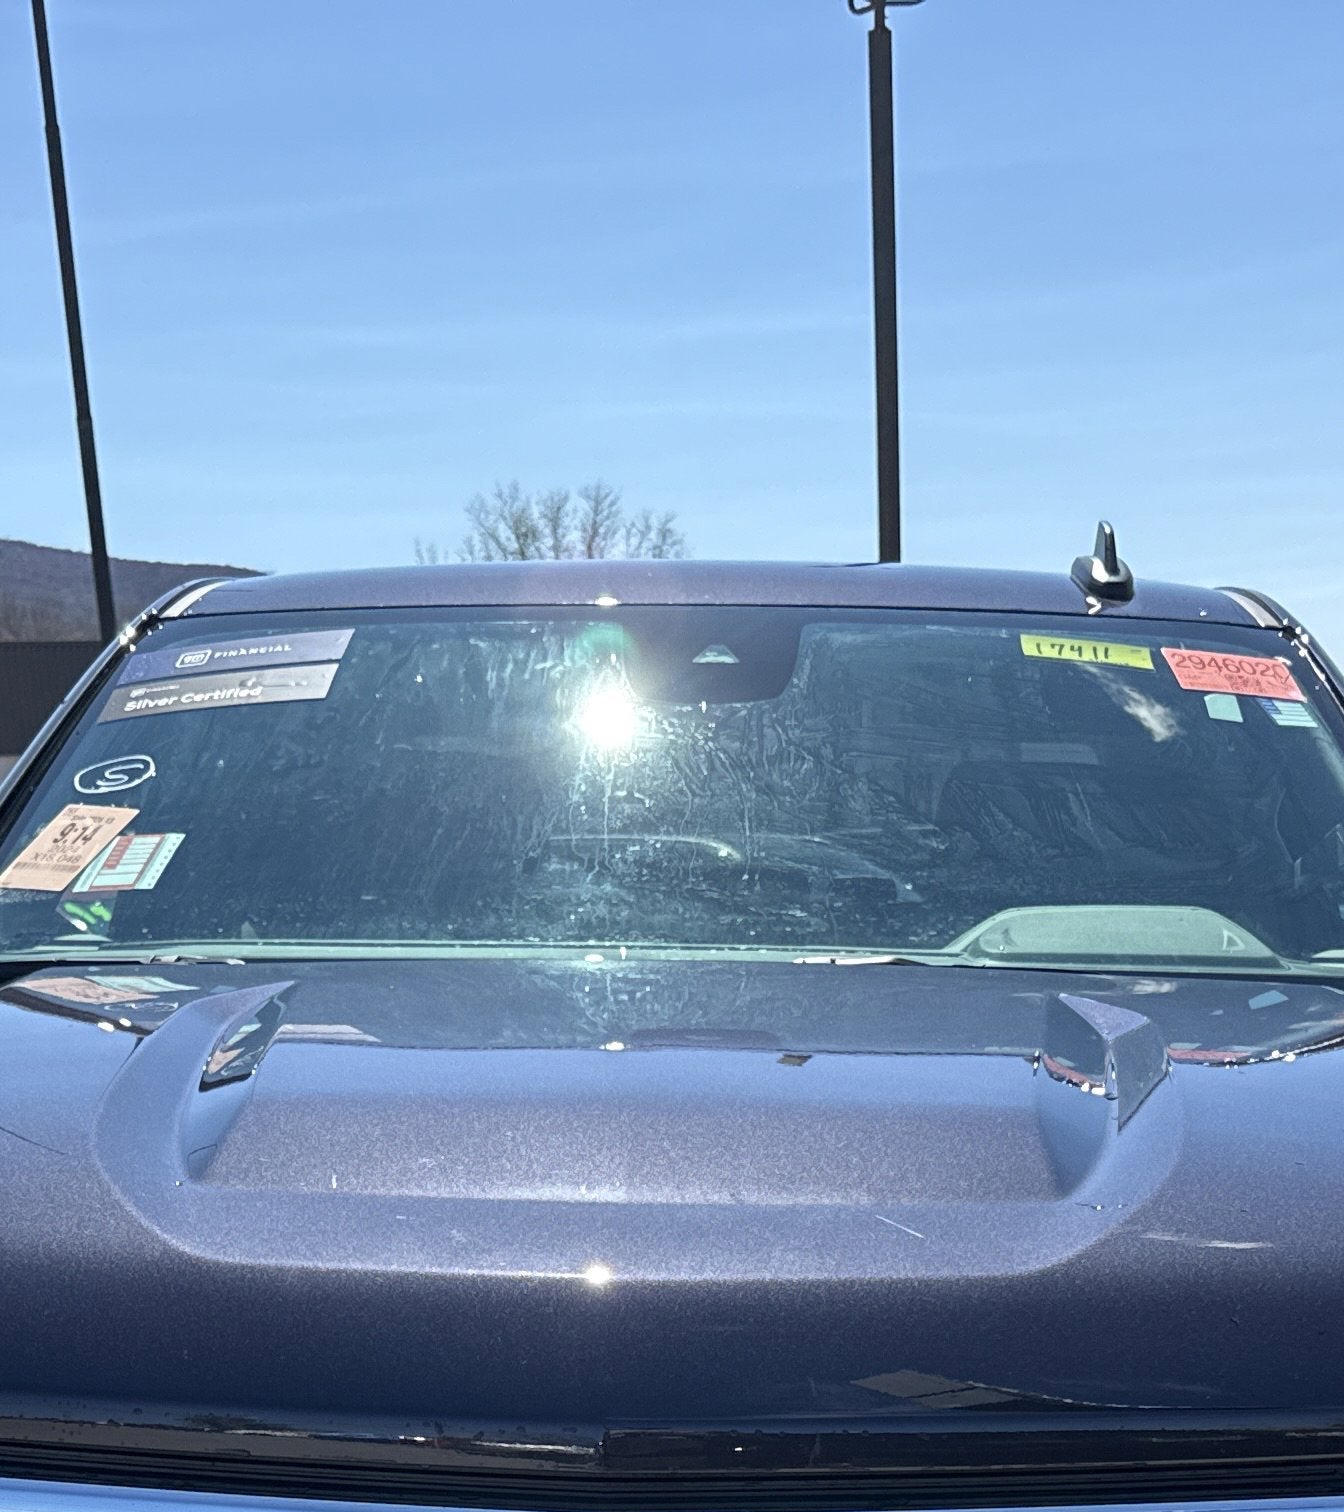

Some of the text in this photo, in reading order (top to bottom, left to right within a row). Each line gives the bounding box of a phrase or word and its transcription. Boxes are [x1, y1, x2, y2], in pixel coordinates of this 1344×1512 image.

[214, 645, 292, 659] FINANCIAL
[124, 697, 179, 712] Silver
[181, 686, 263, 703] Certified
[96, 764, 145, 786] S
[53, 822, 104, 846] 9:14
